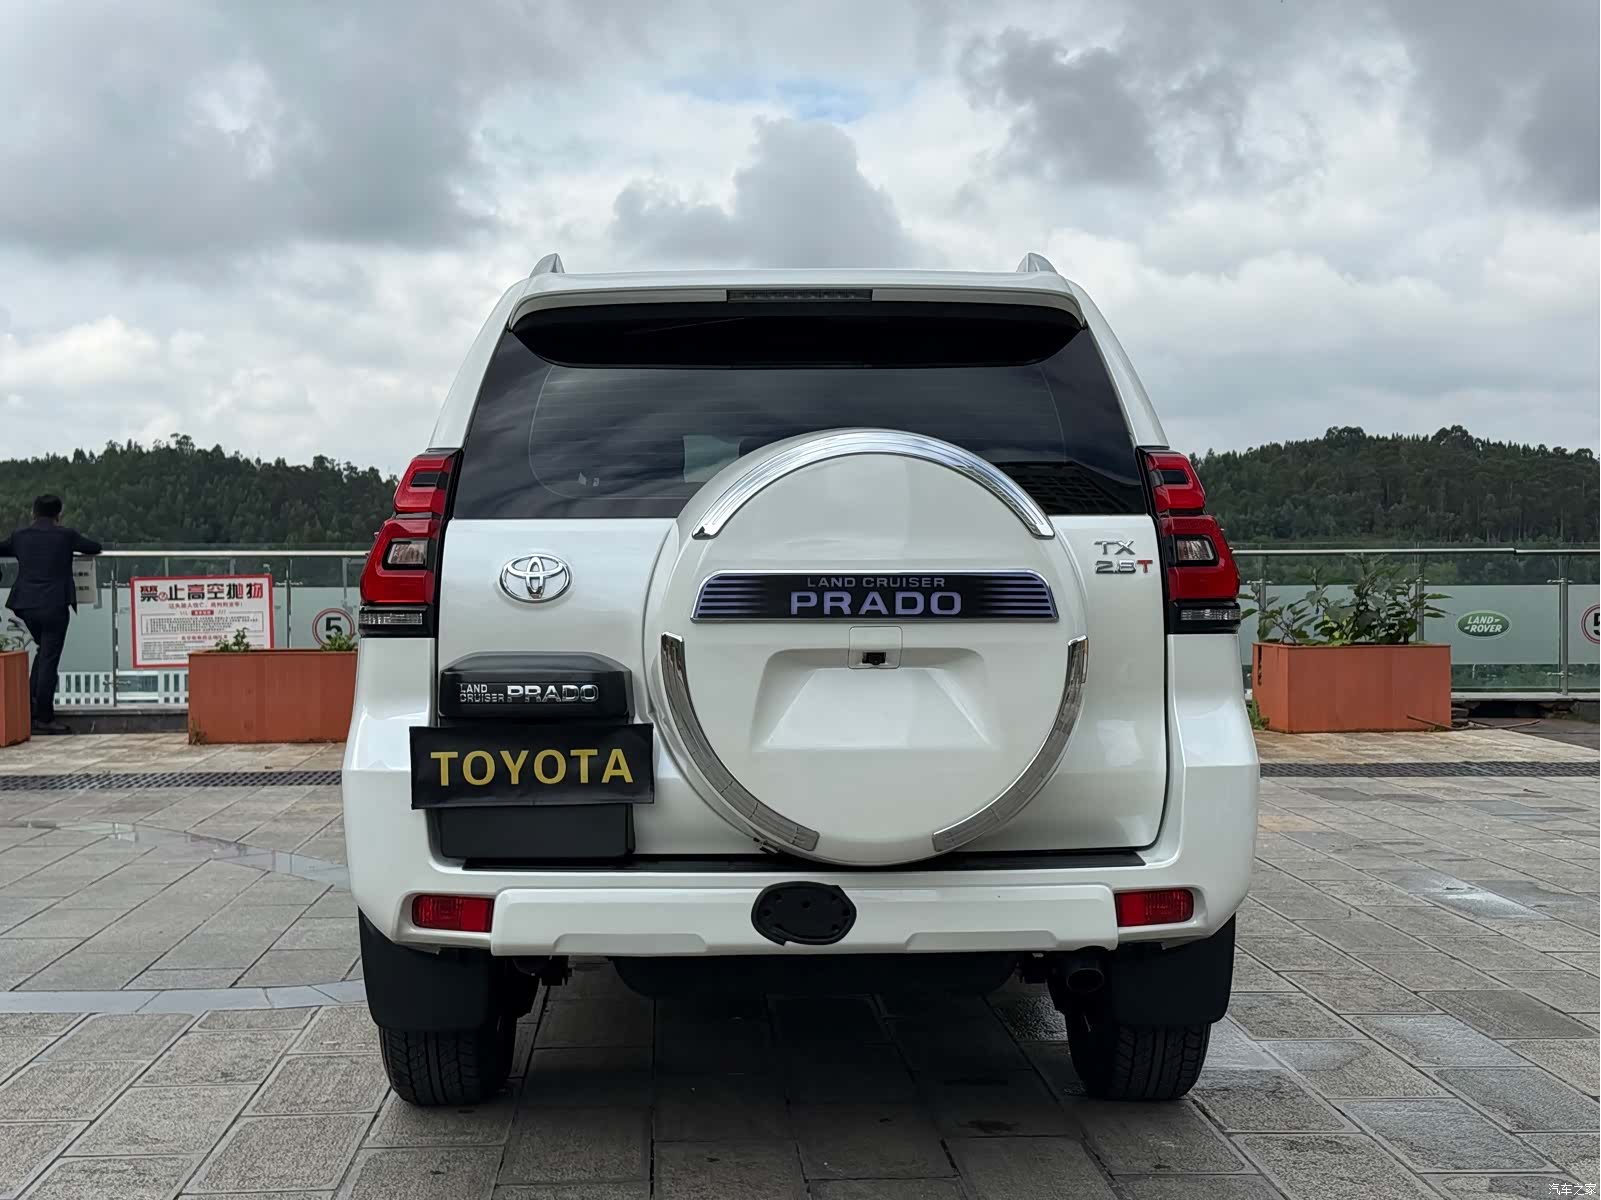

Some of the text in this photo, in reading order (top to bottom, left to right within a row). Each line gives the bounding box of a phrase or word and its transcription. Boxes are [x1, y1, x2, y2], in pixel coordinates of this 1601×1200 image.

[1094, 540, 1136, 556] TX
[1094, 559, 1153, 575] 2.8T
[807, 576, 946, 588] LAND CRUISER
[140, 582, 264, 603] 禁止高空抛物
[790, 591, 962, 616] PRADO
[1467, 616, 1494, 624] LAND
[1470, 624, 1502, 632] ROVER
[325, 616, 343, 641] 5
[459, 683, 488, 694] LAND
[506, 684, 599, 703] PRADO
[459, 693, 505, 703] CRUISER
[430, 748, 634, 787] TOYOTA
